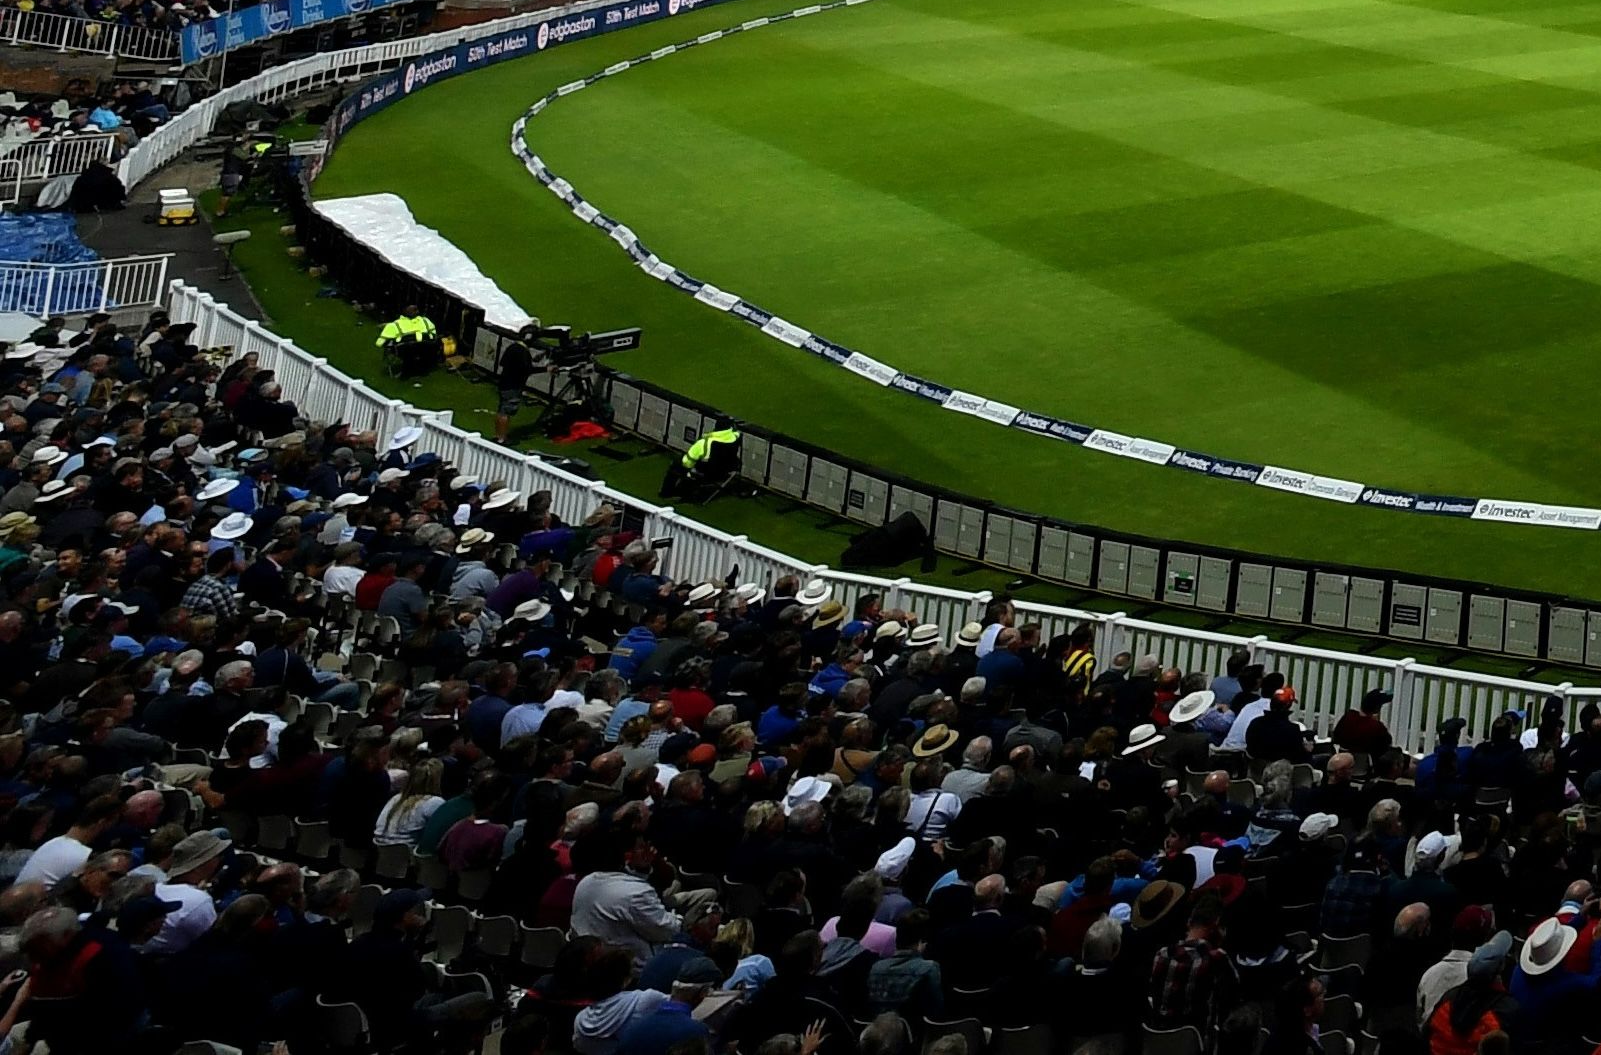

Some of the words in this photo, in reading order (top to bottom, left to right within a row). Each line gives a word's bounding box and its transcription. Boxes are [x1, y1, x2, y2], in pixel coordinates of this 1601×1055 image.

[623, 5, 639, 20] Test
[639, 0, 659, 16] Match
[548, 15, 595, 42] edgbaston
[487, 40, 503, 58] Test
[502, 36, 527, 55] Match
[415, 54, 457, 83] edgbaston
[1270, 471, 1306, 489] Investec
[1372, 491, 1414, 508] Investec
[1488, 504, 1535, 519] Investec
